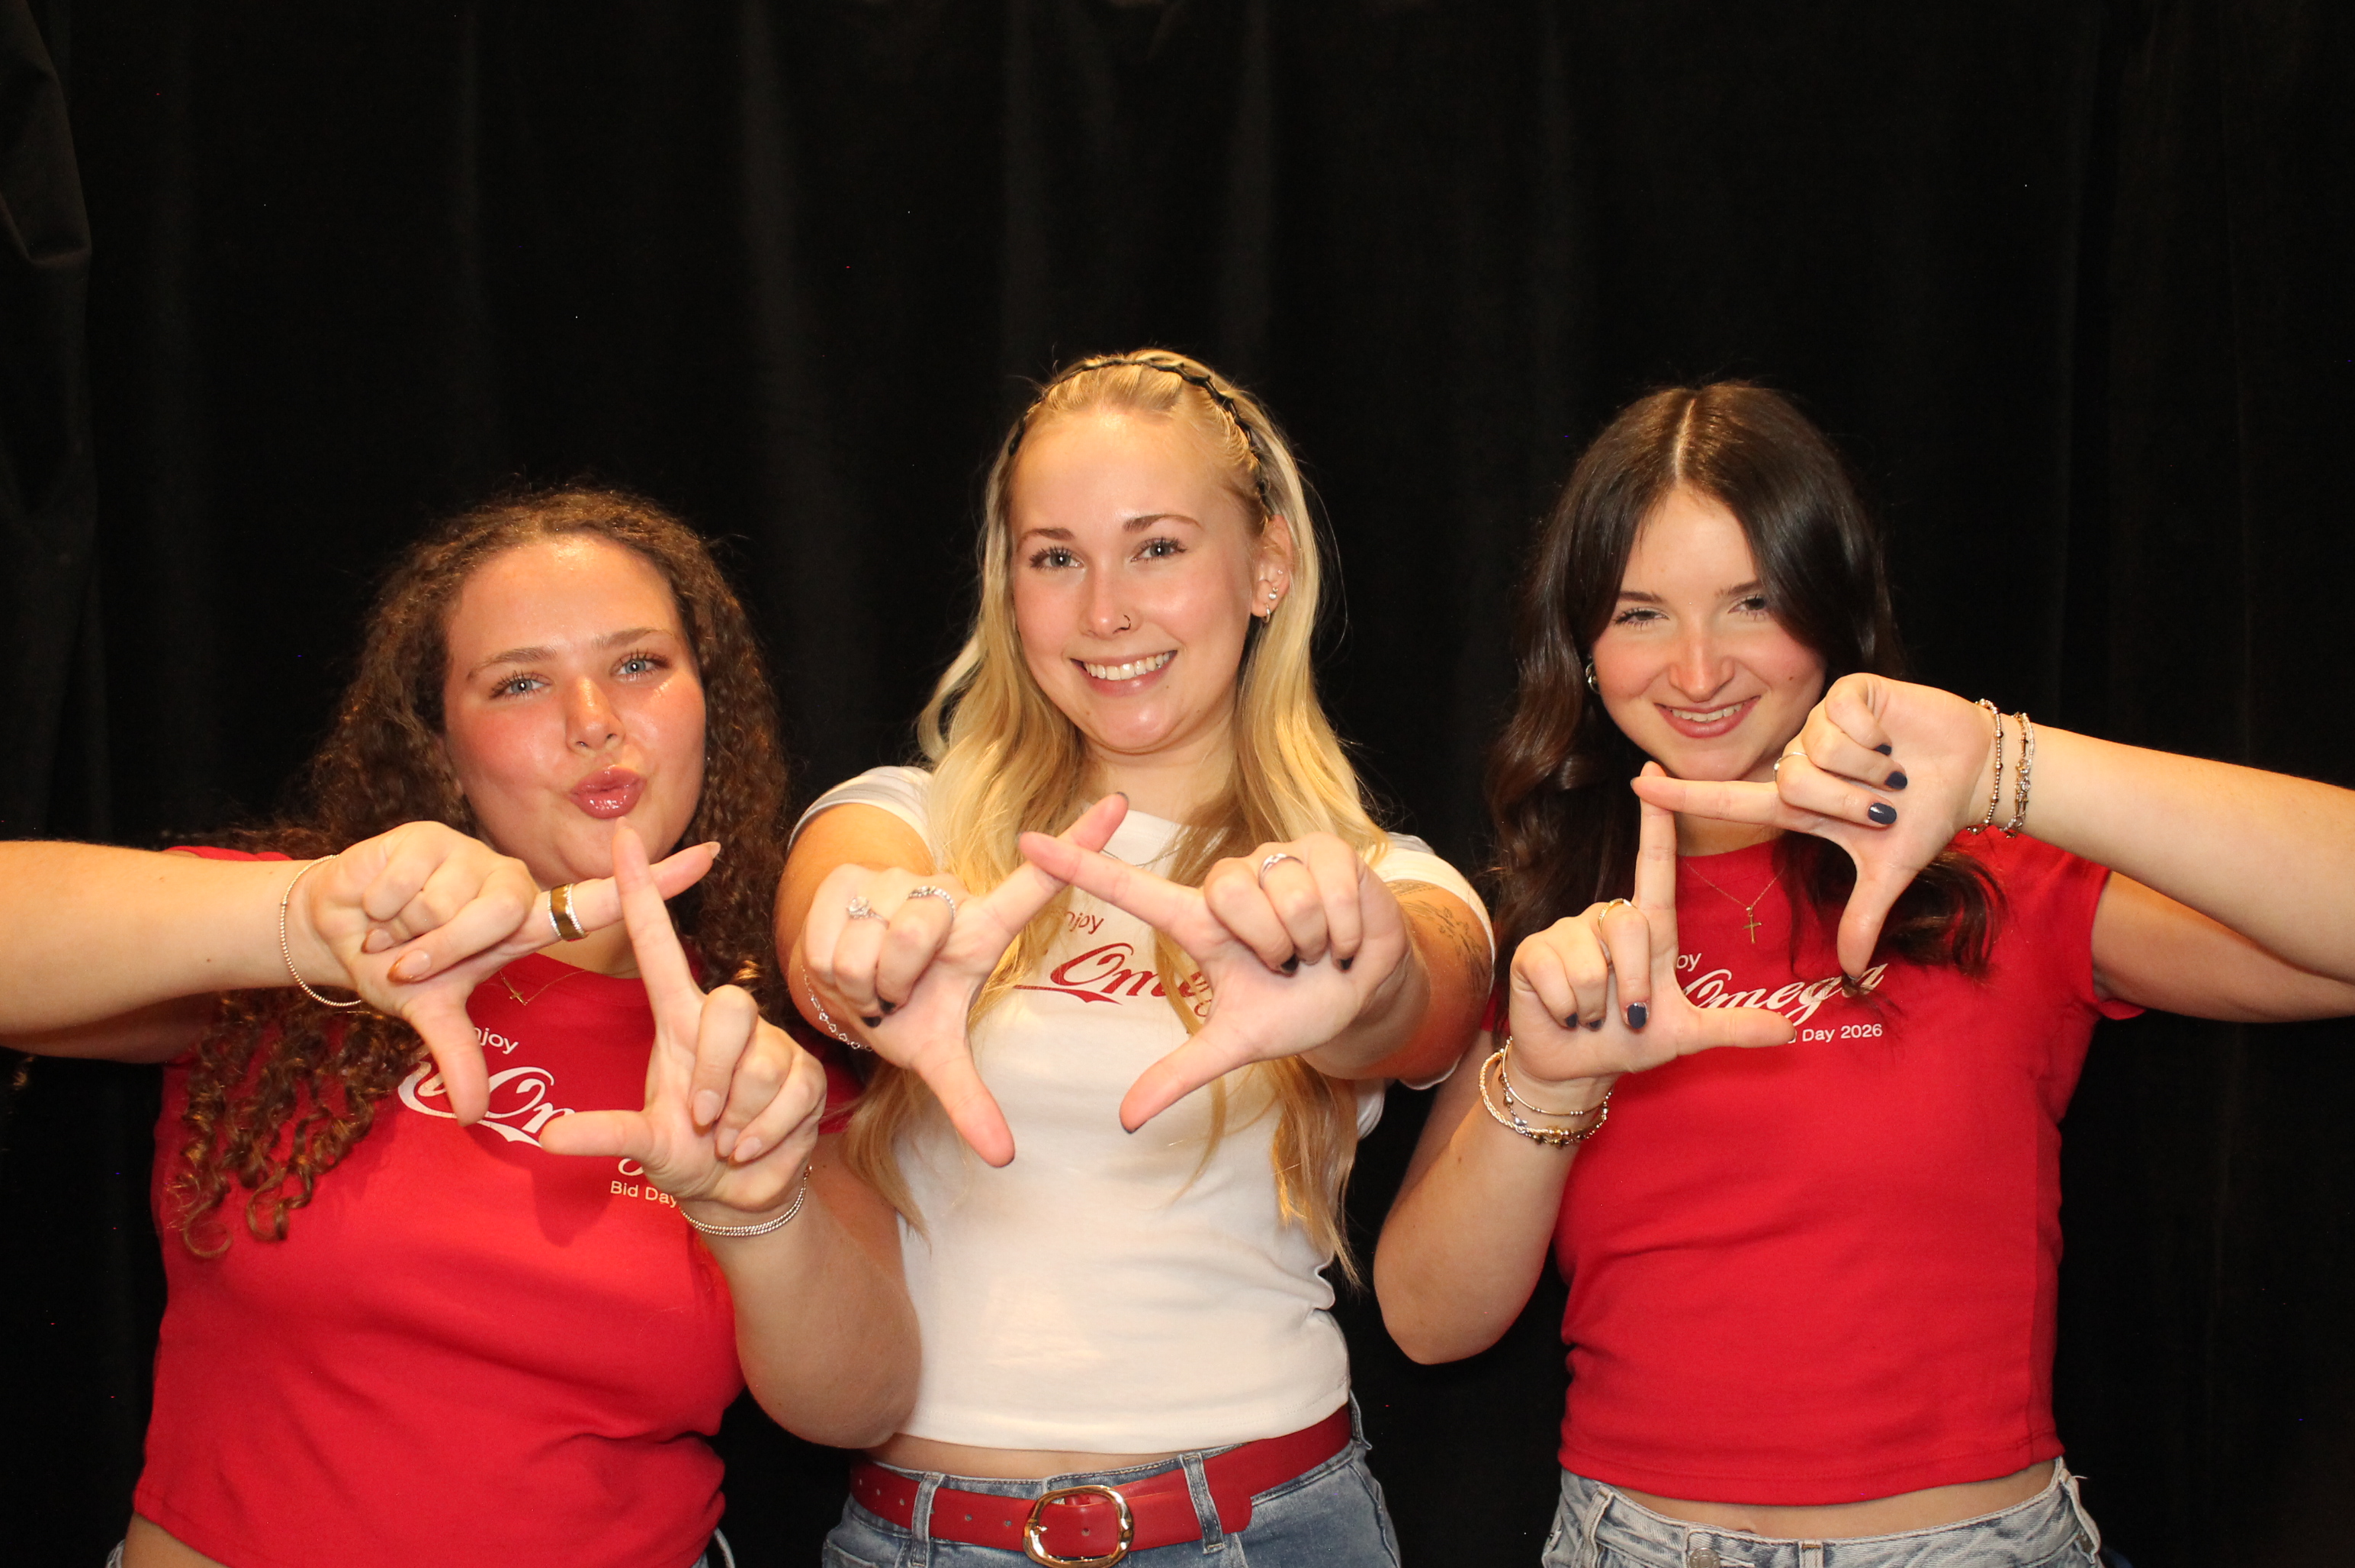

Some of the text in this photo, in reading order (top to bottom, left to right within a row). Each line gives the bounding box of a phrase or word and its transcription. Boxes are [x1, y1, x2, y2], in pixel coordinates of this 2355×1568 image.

[1065, 911, 1104, 935] njoy
[474, 1027, 519, 1055] njoy
[1802, 1029, 1836, 1043] Day
[1840, 1023, 1883, 1039] 2026
[610, 1180, 677, 1208] Bid Day
